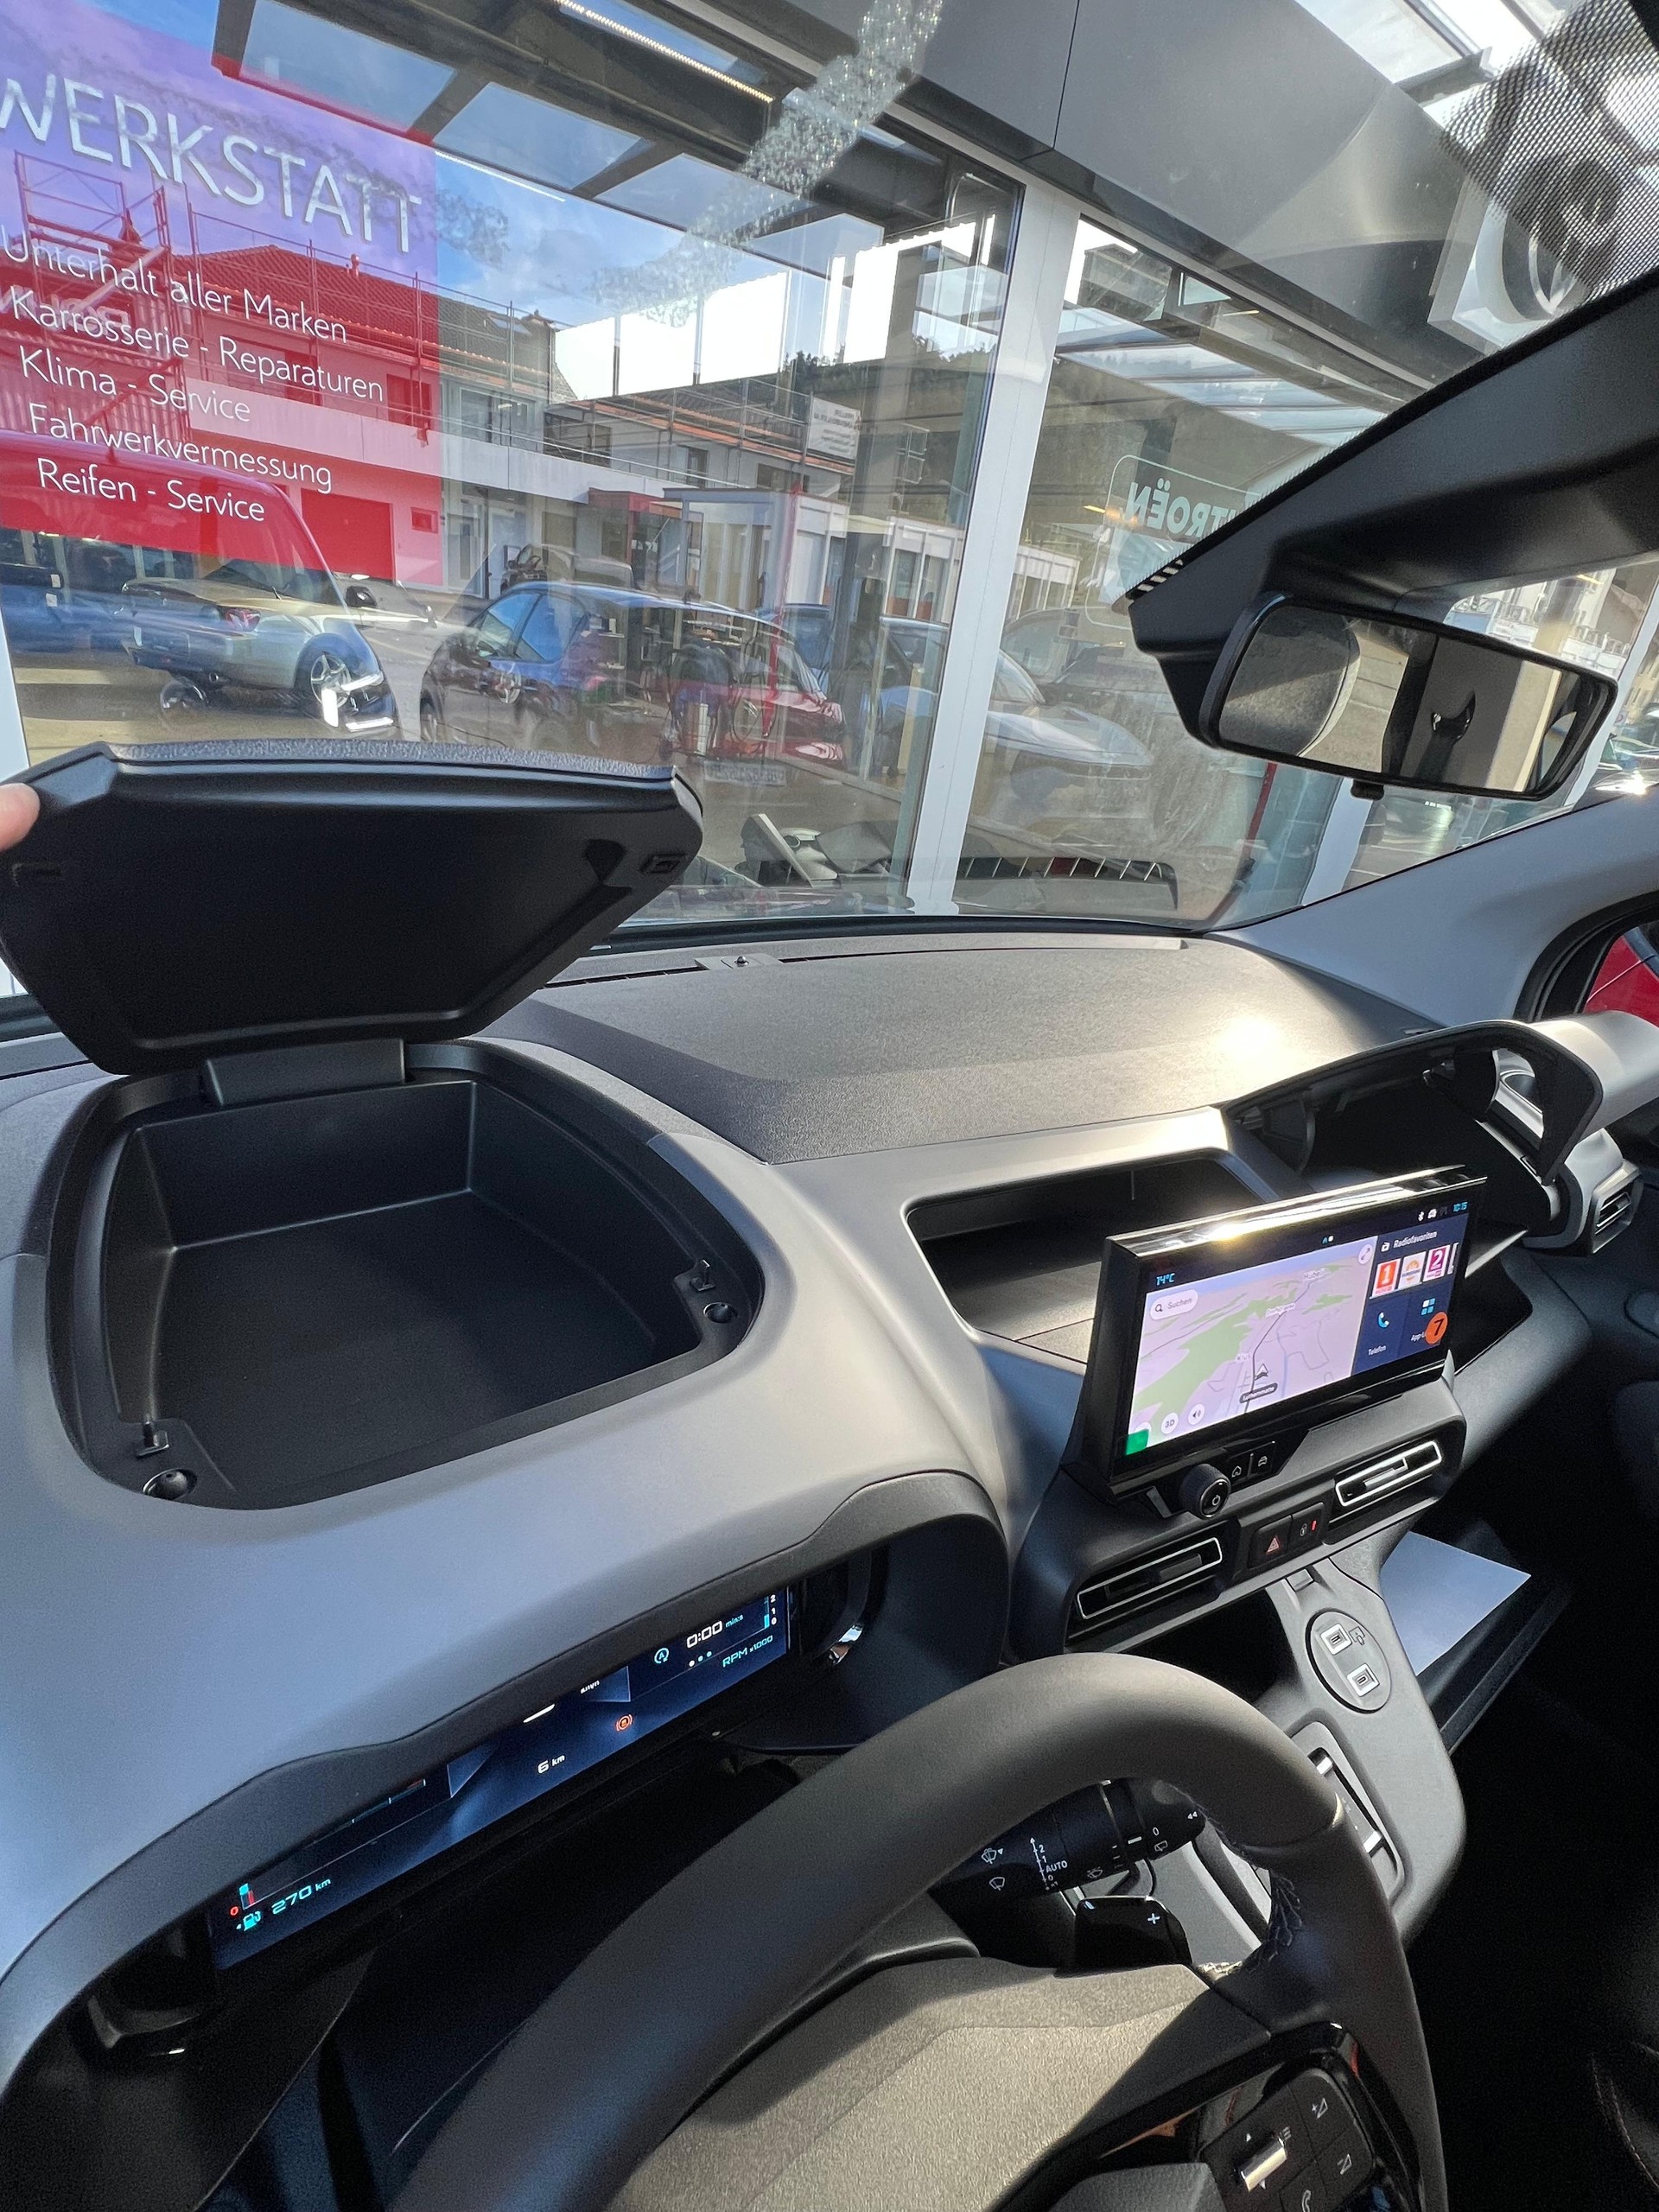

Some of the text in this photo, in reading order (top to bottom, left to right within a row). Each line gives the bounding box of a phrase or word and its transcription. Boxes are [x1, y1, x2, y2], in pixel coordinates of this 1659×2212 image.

[0, 73, 422, 252] WERKSTATT
[2, 225, 159, 297] Unterhalt
[170, 270, 232, 314] aller
[245, 288, 348, 343] Marken
[10, 285, 189, 358] Karrosserie
[220, 336, 384, 402] Reparaturen
[20, 345, 117, 396] Klima
[149, 372, 251, 423] Service
[29, 403, 332, 494] Fahrwerkvermessung
[37, 457, 136, 503] Reifen
[168, 479, 265, 522] Service
[1393, 1231, 1438, 1249] Radiofavoriten
[1430, 1249, 1440, 1270] 2
[1167, 1297, 1192, 1310] Suchen
[1433, 1318, 1445, 1336] 7
[1368, 1345, 1387, 1356] Telefon
[770, 1594, 776, 1604] 2
[771, 1617, 778, 1625] 0
[686, 1620, 723, 1648] 0:00
[722, 1647, 748, 1668] RPM
[537, 1754, 565, 1774] 6 km
[1039, 1844, 1046, 1853] 2
[1046, 1860, 1068, 1873] AUTO
[271, 1878, 331, 1915] 270 km
